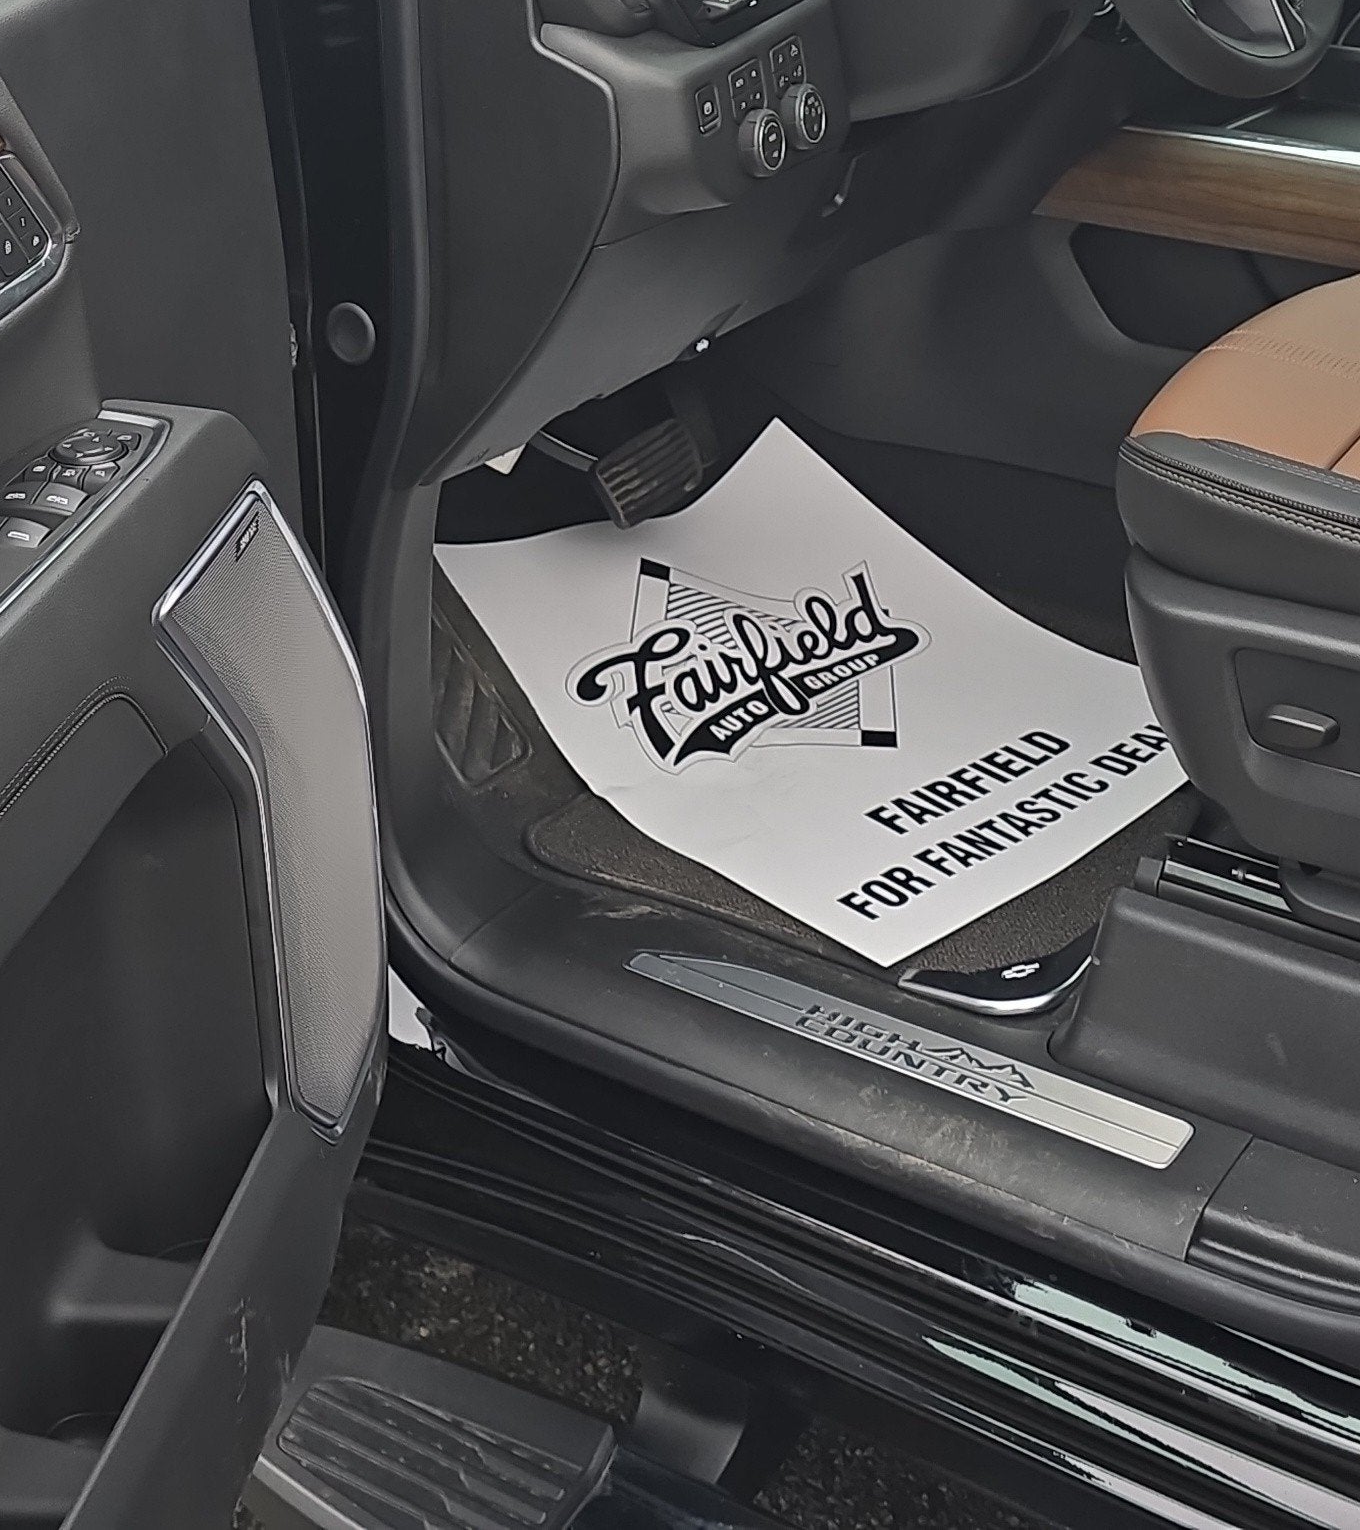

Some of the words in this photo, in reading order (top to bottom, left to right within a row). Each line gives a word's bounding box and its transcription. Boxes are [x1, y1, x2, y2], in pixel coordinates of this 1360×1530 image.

[576, 572, 910, 762] Fairfield
[708, 701, 769, 742] AUTO
[805, 652, 882, 690] GROUP
[863, 730, 1071, 836] FAIRFIELD
[836, 866, 936, 921] FOR
[912, 771, 1110, 878] FANTASTIC
[796, 1015, 1028, 1103] COUNTRY
[805, 1004, 922, 1052] HIGH
